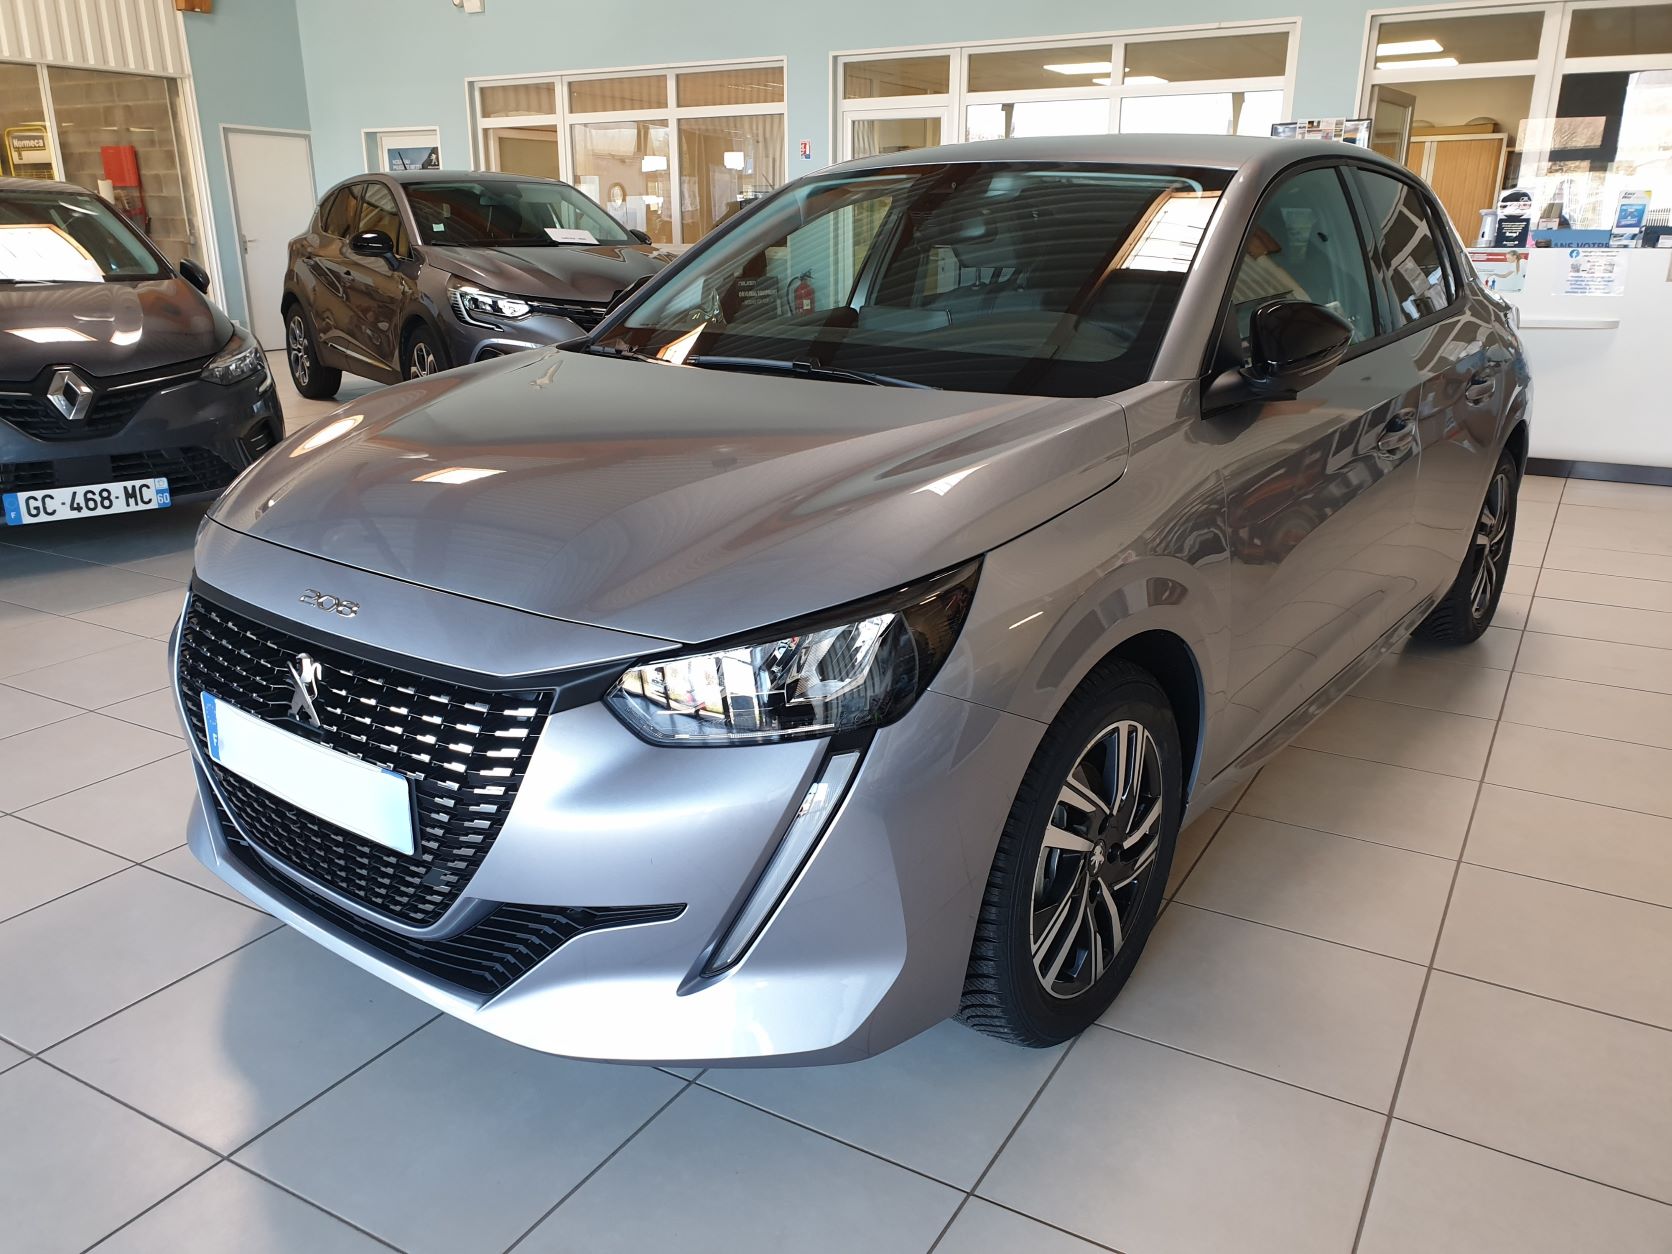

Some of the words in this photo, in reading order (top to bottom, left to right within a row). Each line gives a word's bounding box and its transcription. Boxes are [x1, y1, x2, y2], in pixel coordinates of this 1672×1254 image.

[25, 483, 153, 519] GC-468-MC
[157, 492, 170, 504] 60
[10, 511, 17, 519] F
[299, 588, 360, 618] 208
[212, 732, 219, 747] F
